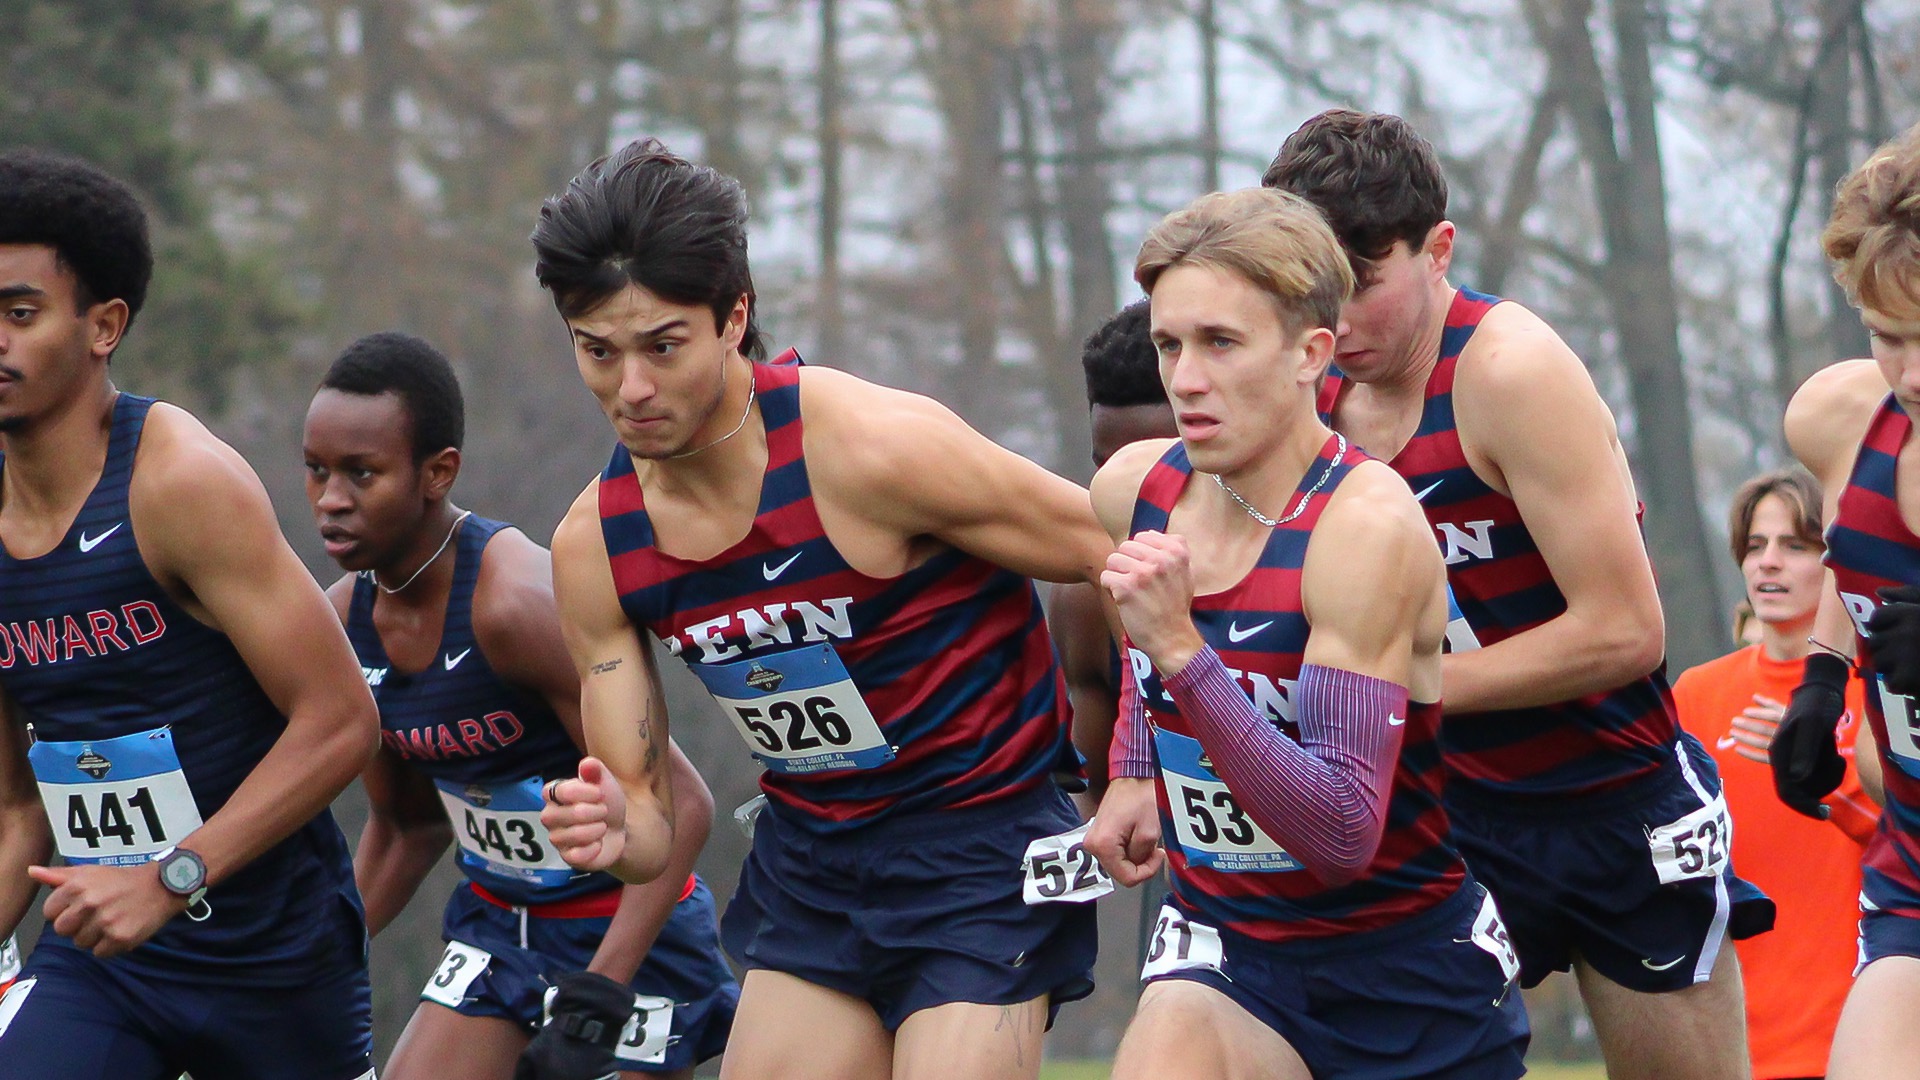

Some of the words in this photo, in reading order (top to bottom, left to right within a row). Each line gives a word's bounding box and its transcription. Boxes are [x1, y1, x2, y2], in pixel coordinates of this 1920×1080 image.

[1128, 648, 1300, 723] PN
[735, 696, 852, 752] 526
[67, 787, 167, 849] 441
[465, 808, 545, 863] 443
[1181, 784, 1255, 846] 53
[1031, 841, 1111, 897] 52
